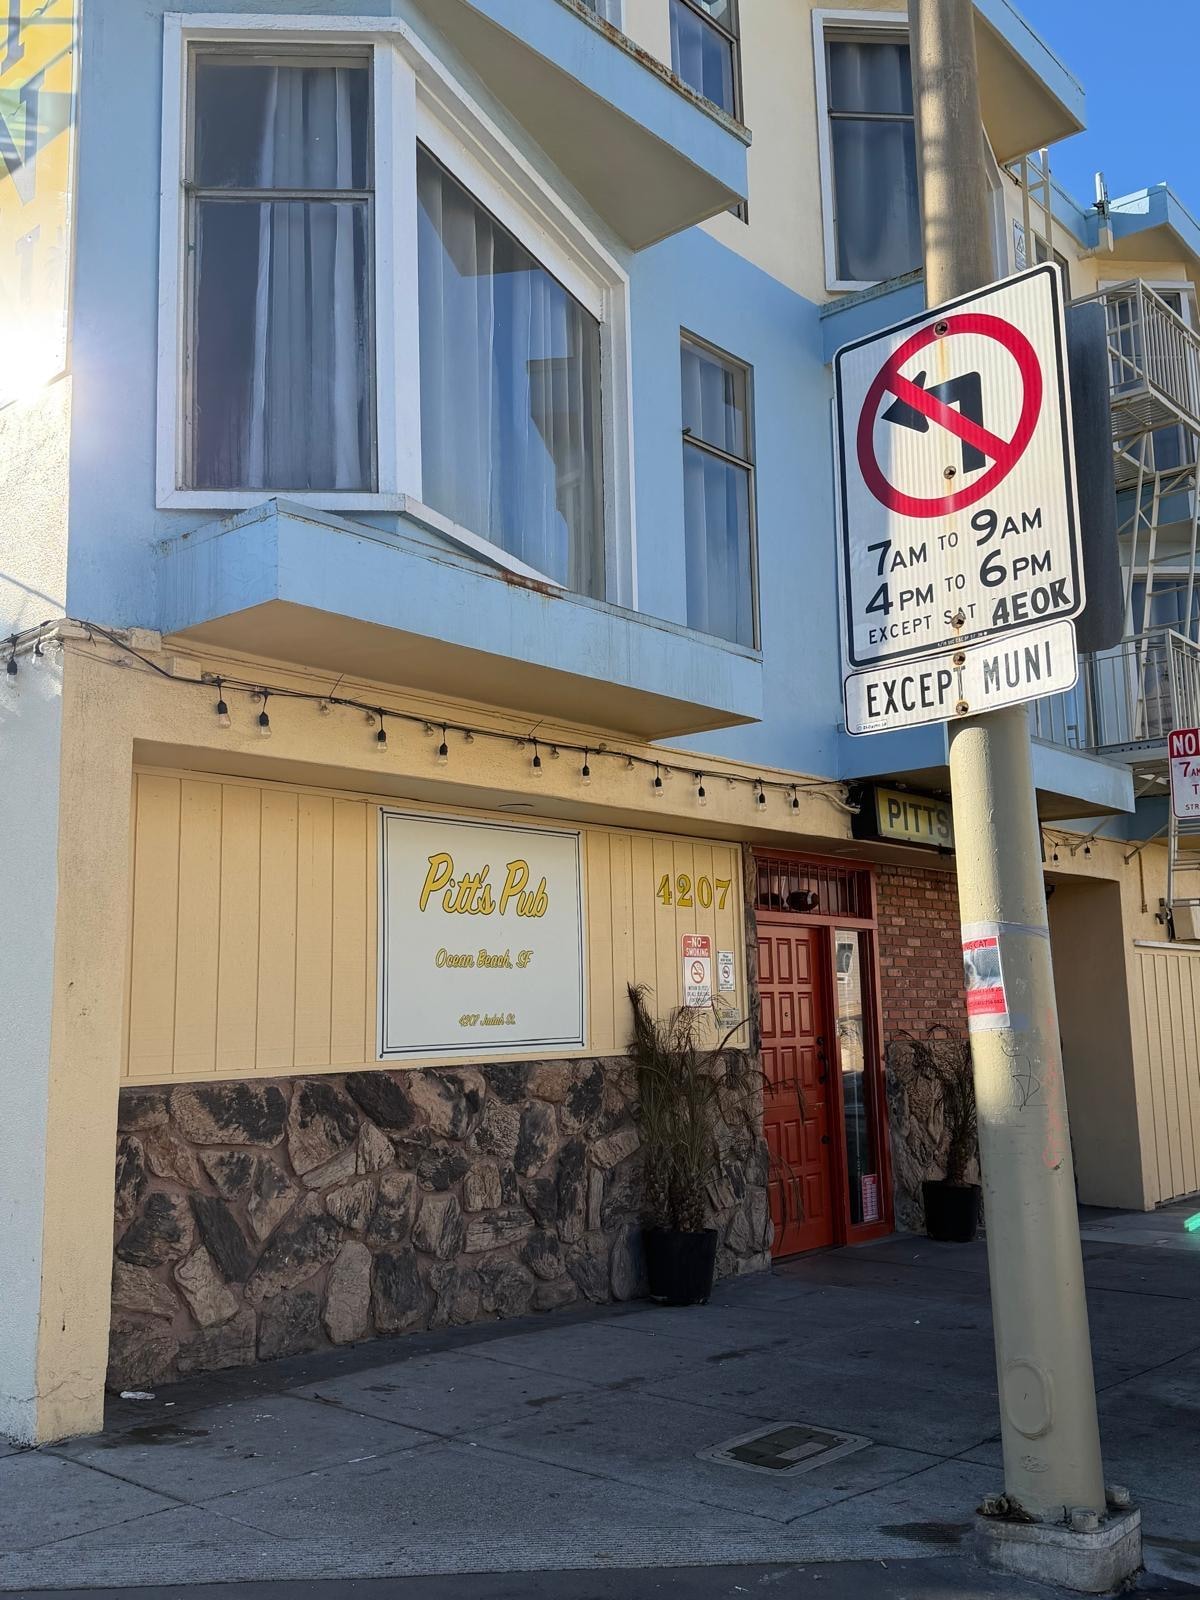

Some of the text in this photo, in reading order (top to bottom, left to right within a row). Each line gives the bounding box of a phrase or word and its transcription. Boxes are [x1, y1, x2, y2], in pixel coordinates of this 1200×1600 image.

[867, 507, 1042, 576] 7AM TO 9AM
[865, 549, 1052, 616] 4PM TO 6PM
[869, 615, 932, 645] EXCEPT
[866, 641, 1053, 718] EXCEPT MUNI
[1172, 732, 1197, 756] NO
[419, 852, 549, 917] Pitt's Pub
[656, 873, 732, 910] 4207
[436, 948, 475, 968] Ocean
[516, 949, 534, 968] SF
[686, 947, 709, 957] SMOKING
